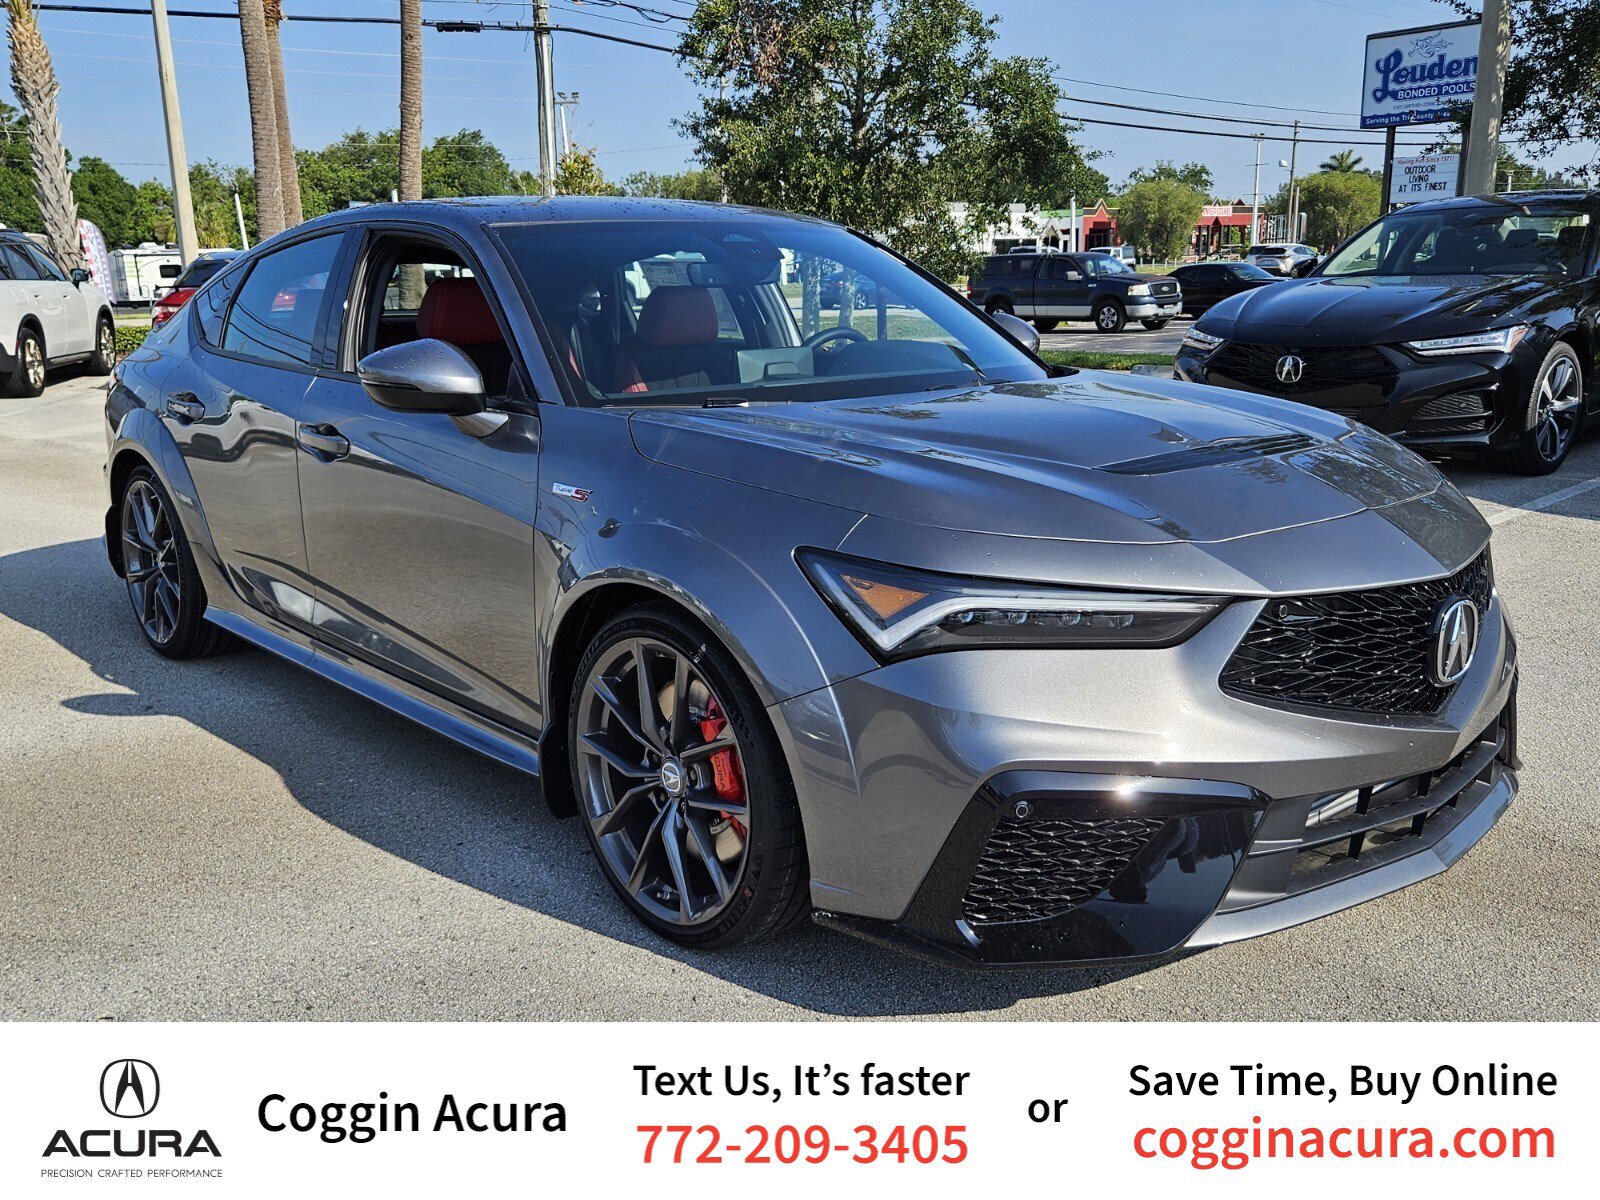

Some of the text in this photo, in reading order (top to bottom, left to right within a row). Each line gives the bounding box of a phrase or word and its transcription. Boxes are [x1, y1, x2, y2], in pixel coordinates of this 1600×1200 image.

[1397, 83, 1476, 99] BONDED POOLS
[1366, 117, 1389, 125] Serving
[1390, 115, 1400, 123] the
[1404, 165, 1436, 175] OUTDOOR
[1408, 174, 1429, 184] LIVING
[1398, 181, 1447, 193] AT ITS FINEST
